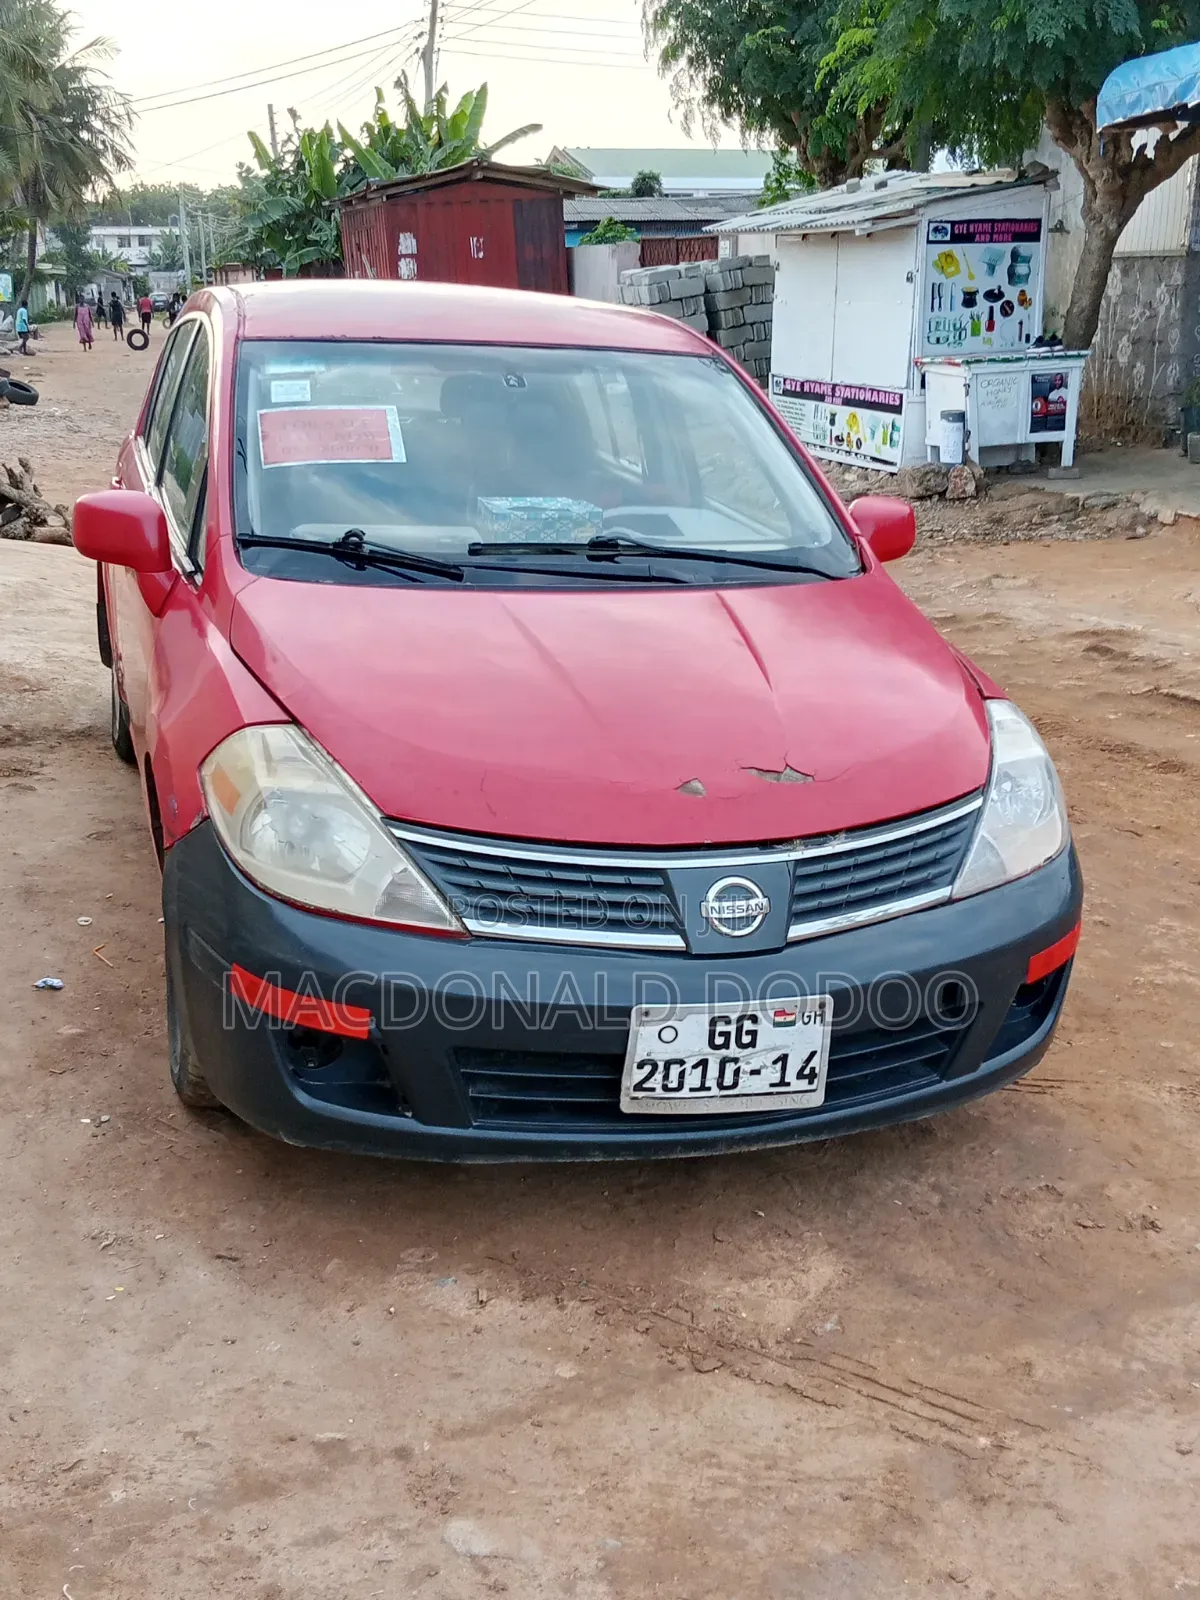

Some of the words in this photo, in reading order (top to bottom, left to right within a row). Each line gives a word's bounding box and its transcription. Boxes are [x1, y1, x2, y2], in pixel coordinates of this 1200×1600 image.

[954, 223, 967, 234] GYE
[969, 223, 992, 233] NYAME
[994, 222, 1038, 232] STATIONARIES
[784, 378, 801, 392] GYE
[803, 381, 833, 396] NYAME
[834, 386, 900, 406] STATIONARIES
[980, 376, 1019, 390] ORGANIC
[710, 902, 765, 915] NISSAN
[707, 1013, 759, 1051] GG
[801, 1009, 825, 1026] GH
[632, 1050, 818, 1093] 2010-14
